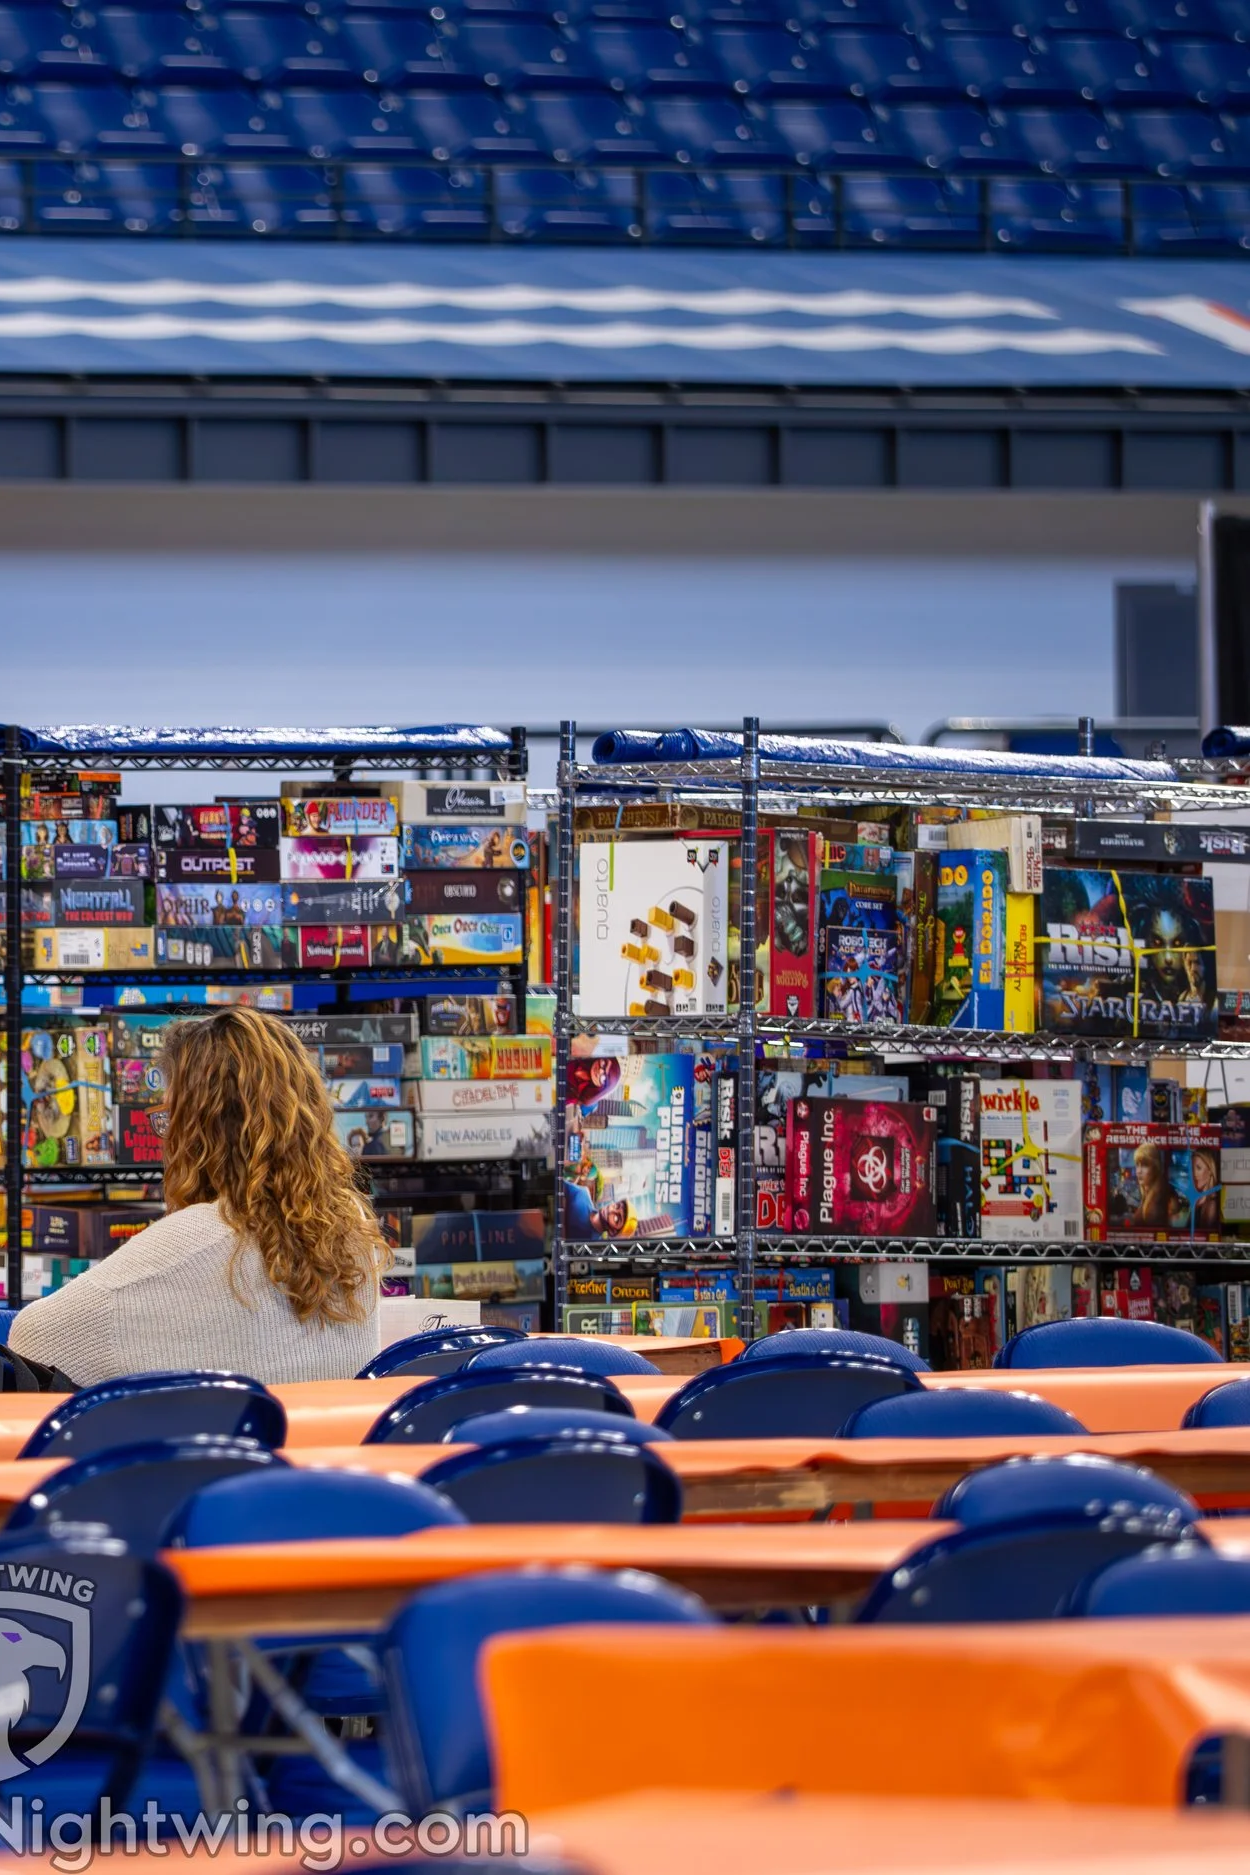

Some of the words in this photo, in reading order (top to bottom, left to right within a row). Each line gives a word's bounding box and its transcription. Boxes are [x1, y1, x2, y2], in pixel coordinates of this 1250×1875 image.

[326, 801, 387, 829] PLUNDER
[703, 813, 767, 828] PARCHSI
[60, 888, 134, 911] NIGHTFALL
[165, 897, 209, 915] OPHIR
[979, 870, 994, 955] DORADO
[336, 945, 365, 955] ersonal
[839, 935, 887, 949] ROBOECH
[979, 960, 992, 984] EL
[290, 1021, 328, 1039] YSSEY
[980, 1088, 1040, 1112] wirkle
[819, 1108, 834, 1143] Inc.
[1126, 1126, 1147, 1135] THE
[669, 1086, 685, 1204] QUADRO
[1106, 1135, 1167, 1146] RESISTANCE
[799, 1131, 809, 1175] Plague
[820, 1149, 837, 1224] Plague
